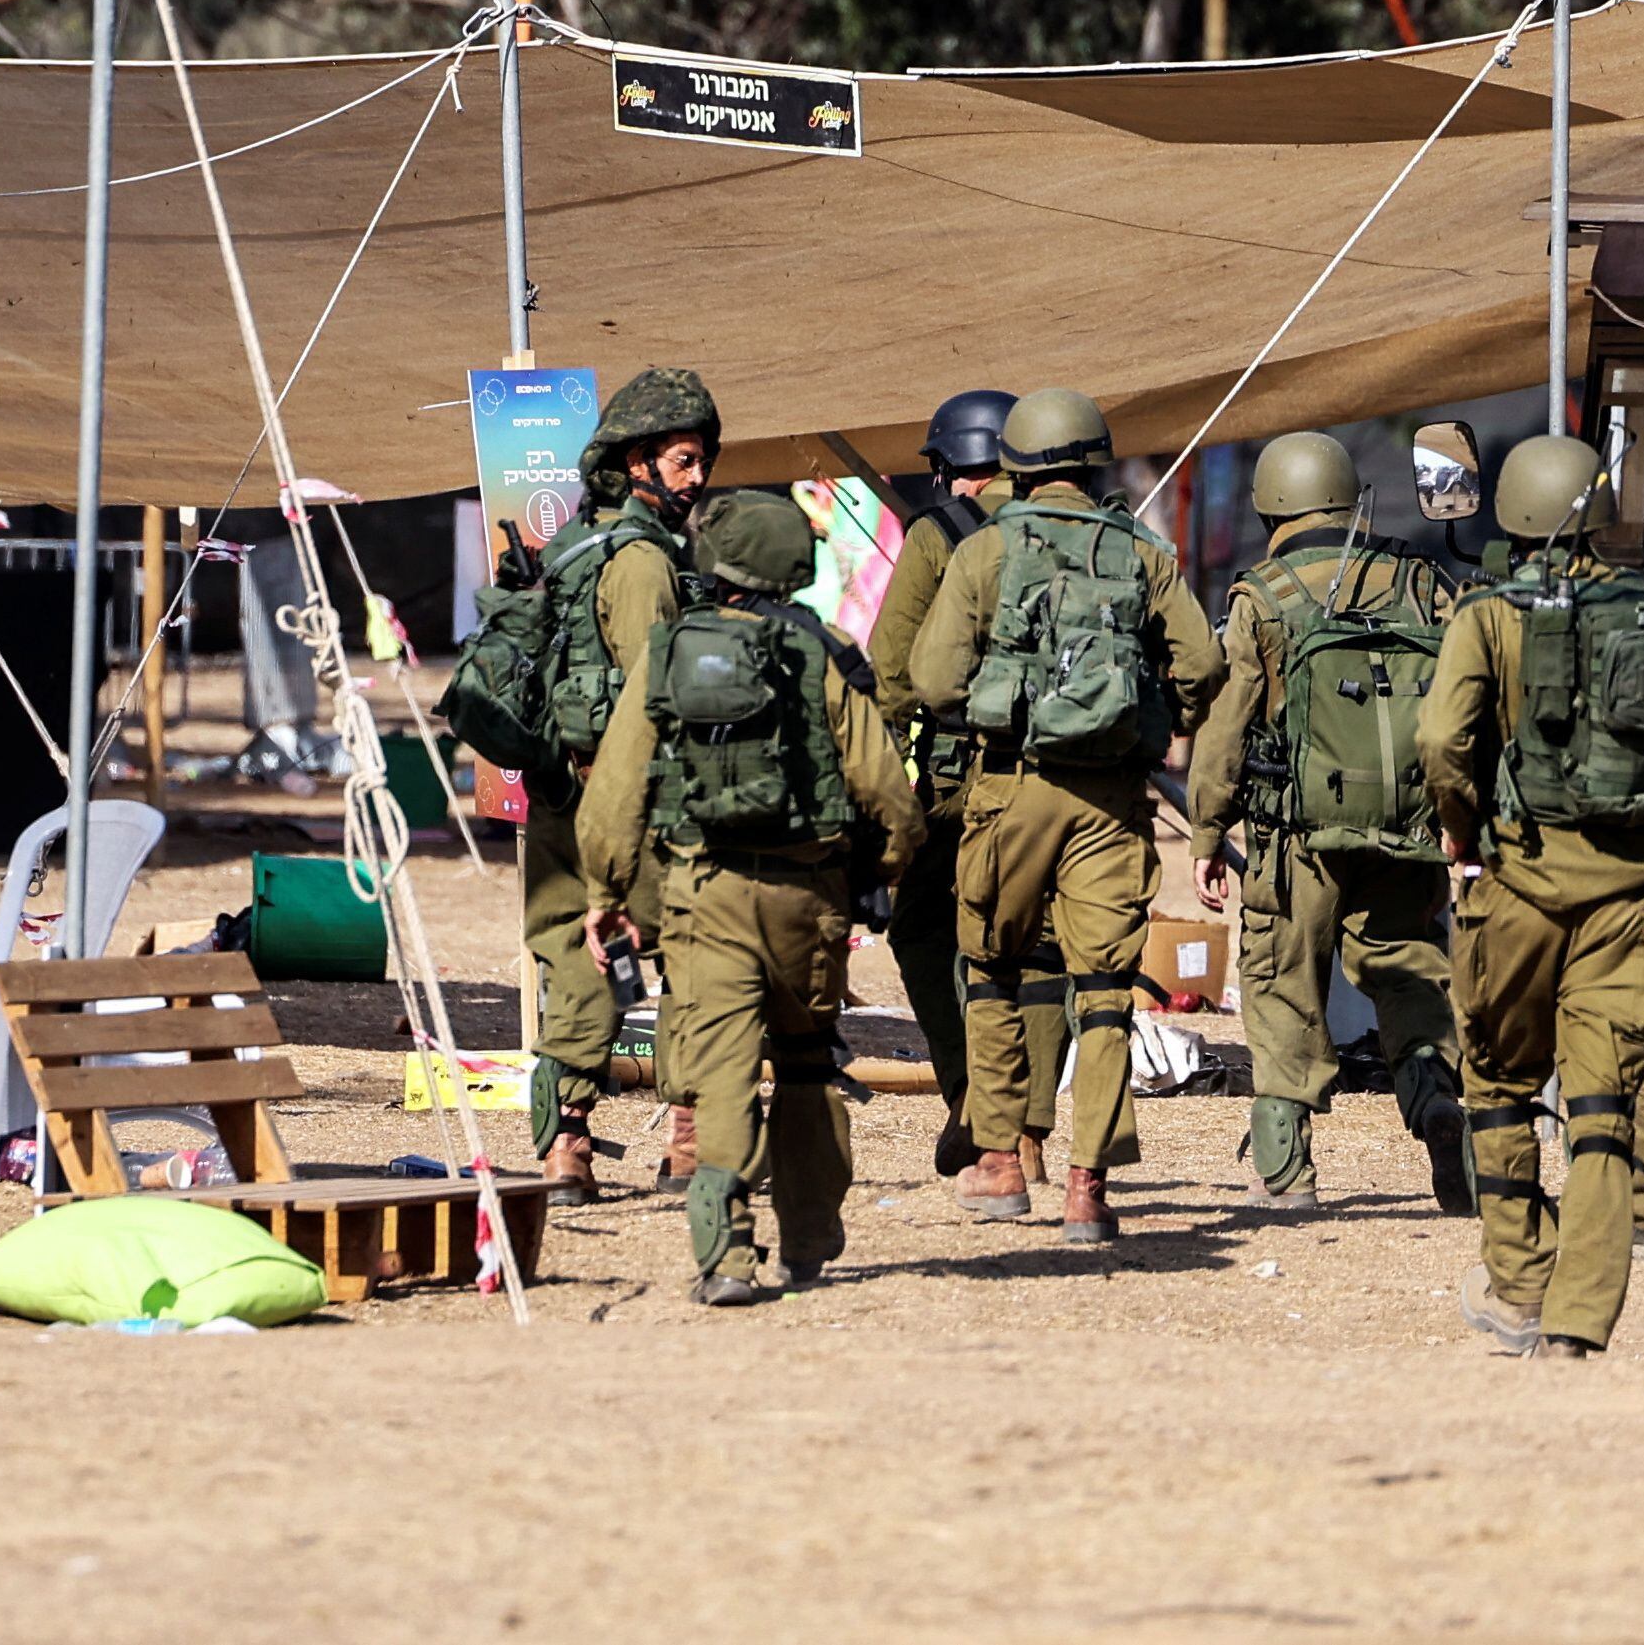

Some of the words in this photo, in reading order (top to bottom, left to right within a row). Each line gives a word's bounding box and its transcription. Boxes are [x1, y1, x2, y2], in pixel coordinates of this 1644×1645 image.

[688, 72, 769, 102] המבורגר
[685, 102, 776, 134] אנטריקוט
[515, 385, 552, 394] ECONOVA
[513, 418, 544, 428] זורקים
[545, 418, 561, 426] פה
[526, 450, 555, 466] רק
[503, 469, 581, 486] פלסטיק
